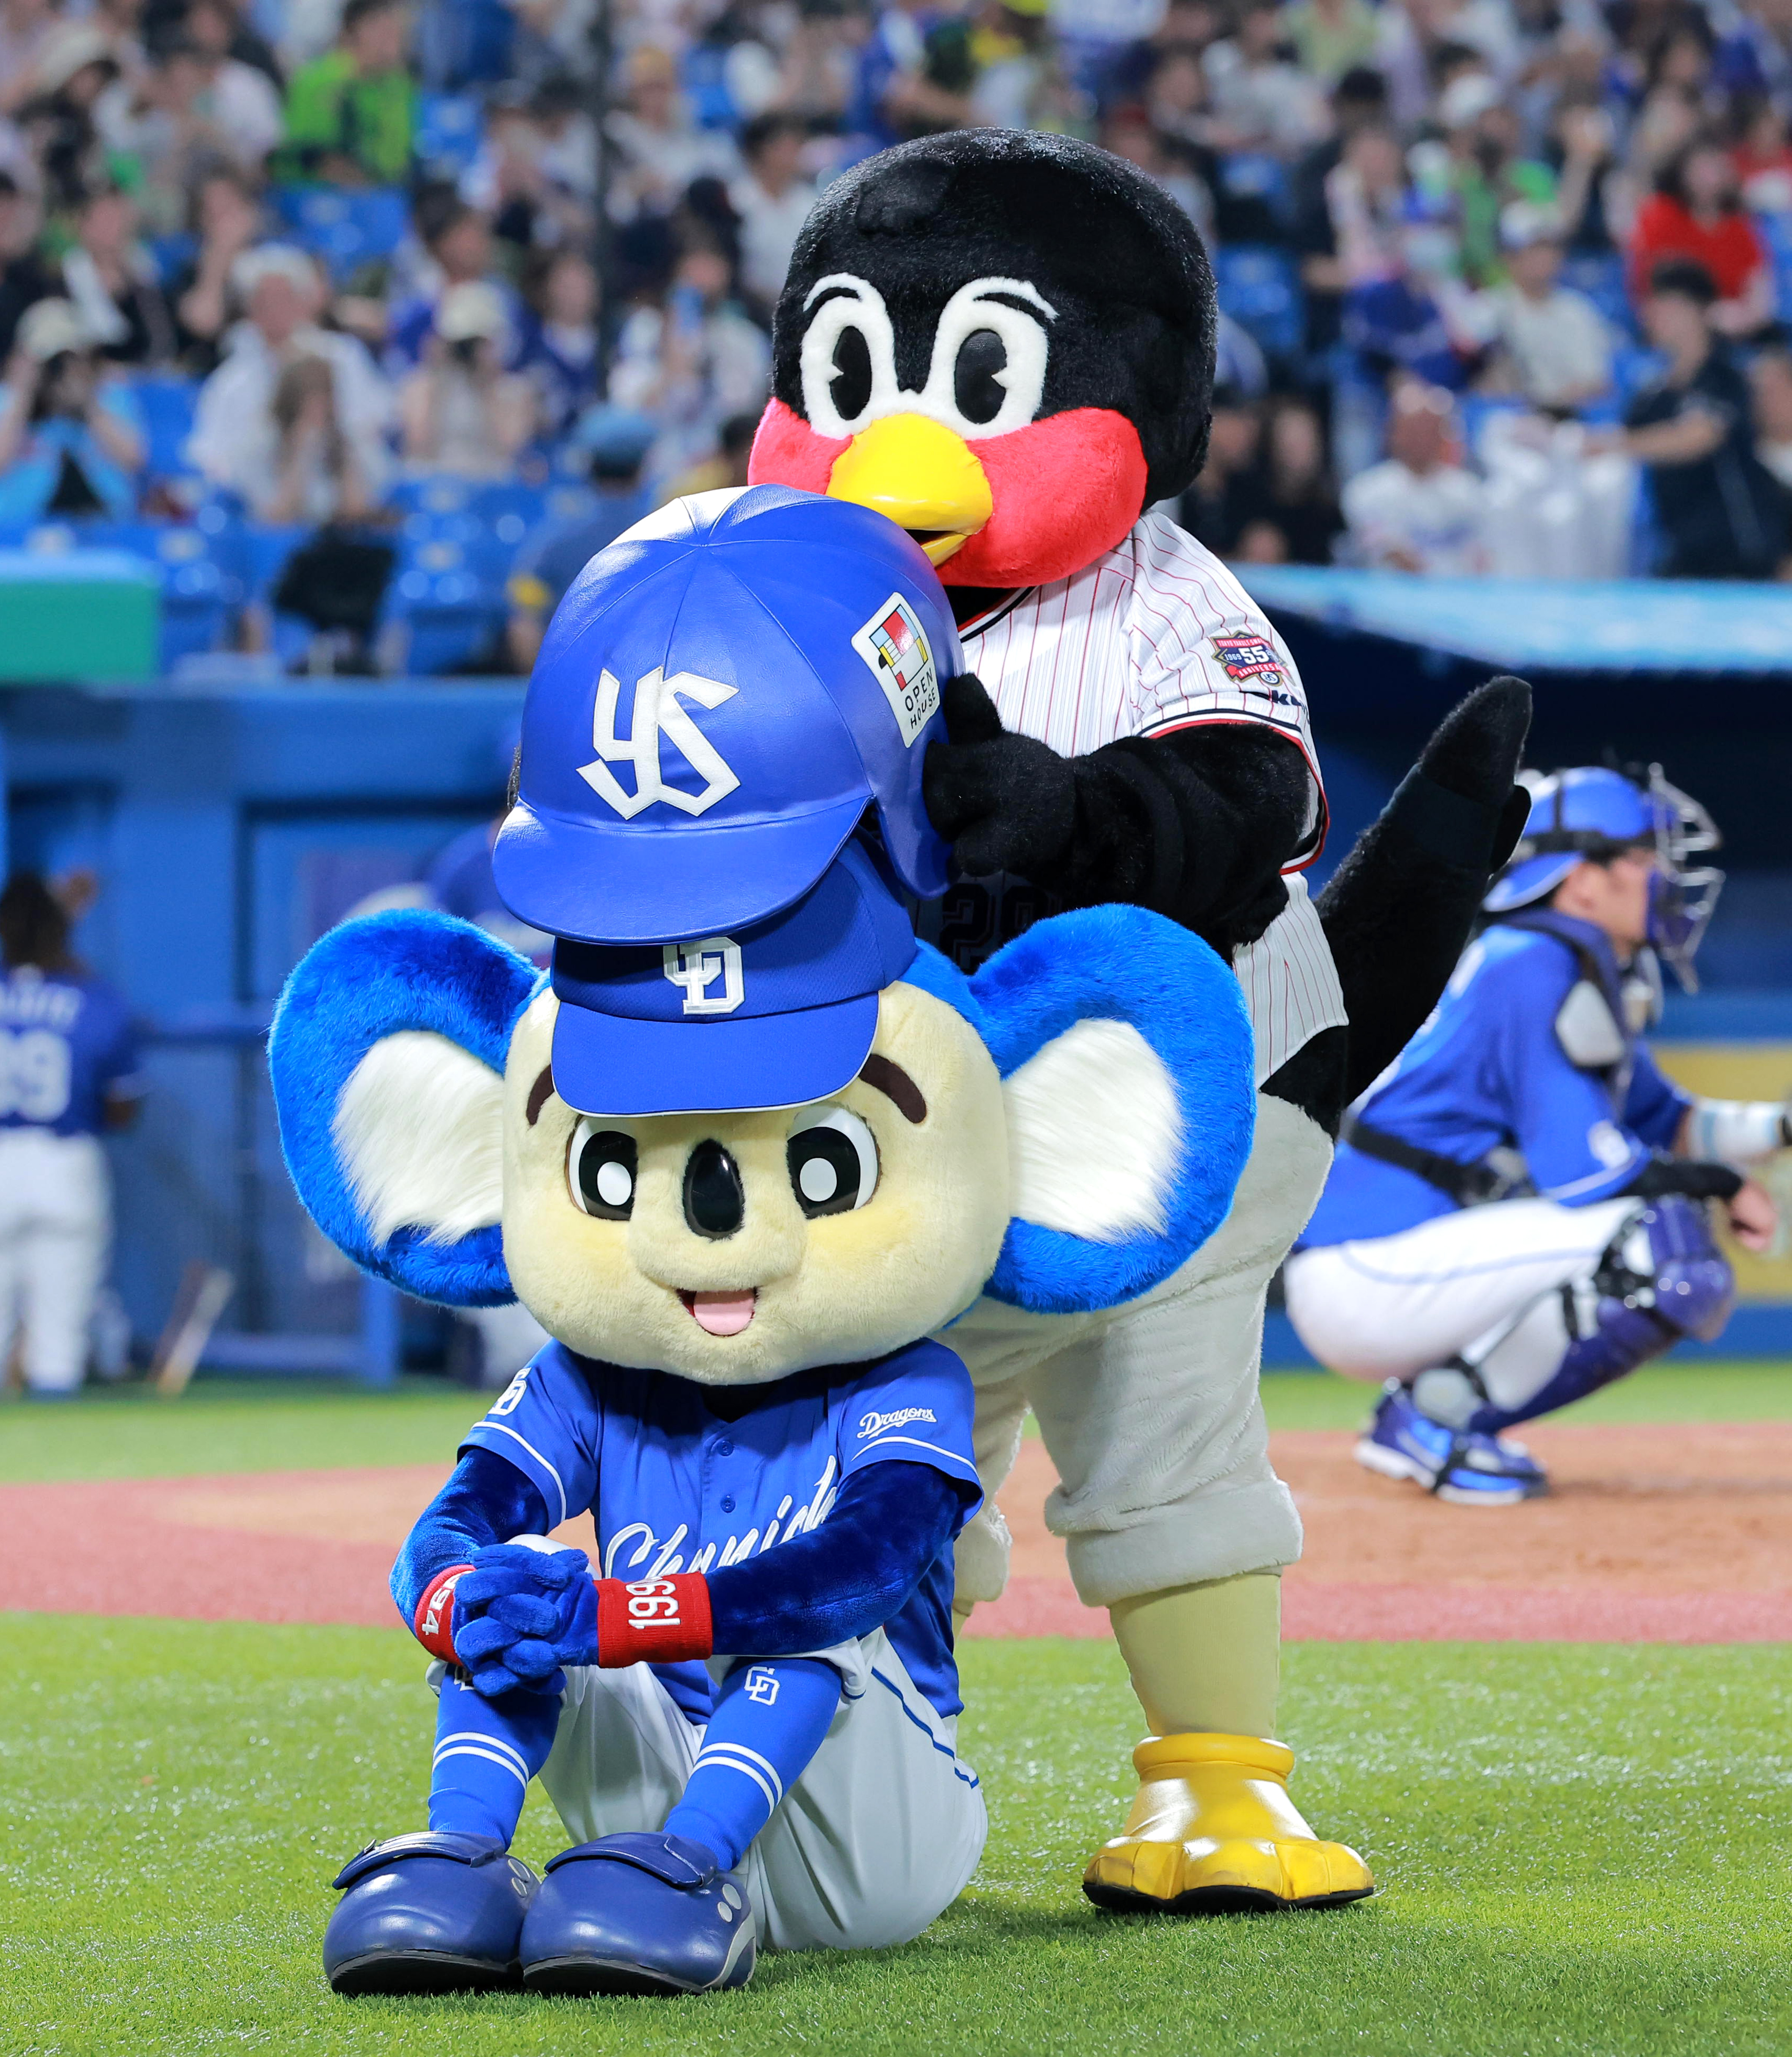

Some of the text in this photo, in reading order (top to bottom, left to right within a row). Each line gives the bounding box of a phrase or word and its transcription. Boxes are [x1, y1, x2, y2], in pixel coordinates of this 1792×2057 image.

[1238, 645, 1269, 664] 55
[905, 668, 933, 712] OPEN
[910, 687, 936, 730] HOUSE
[576, 664, 741, 821] YS
[857, 1407, 937, 1440] Dragons
[626, 1576, 681, 1630] 199
